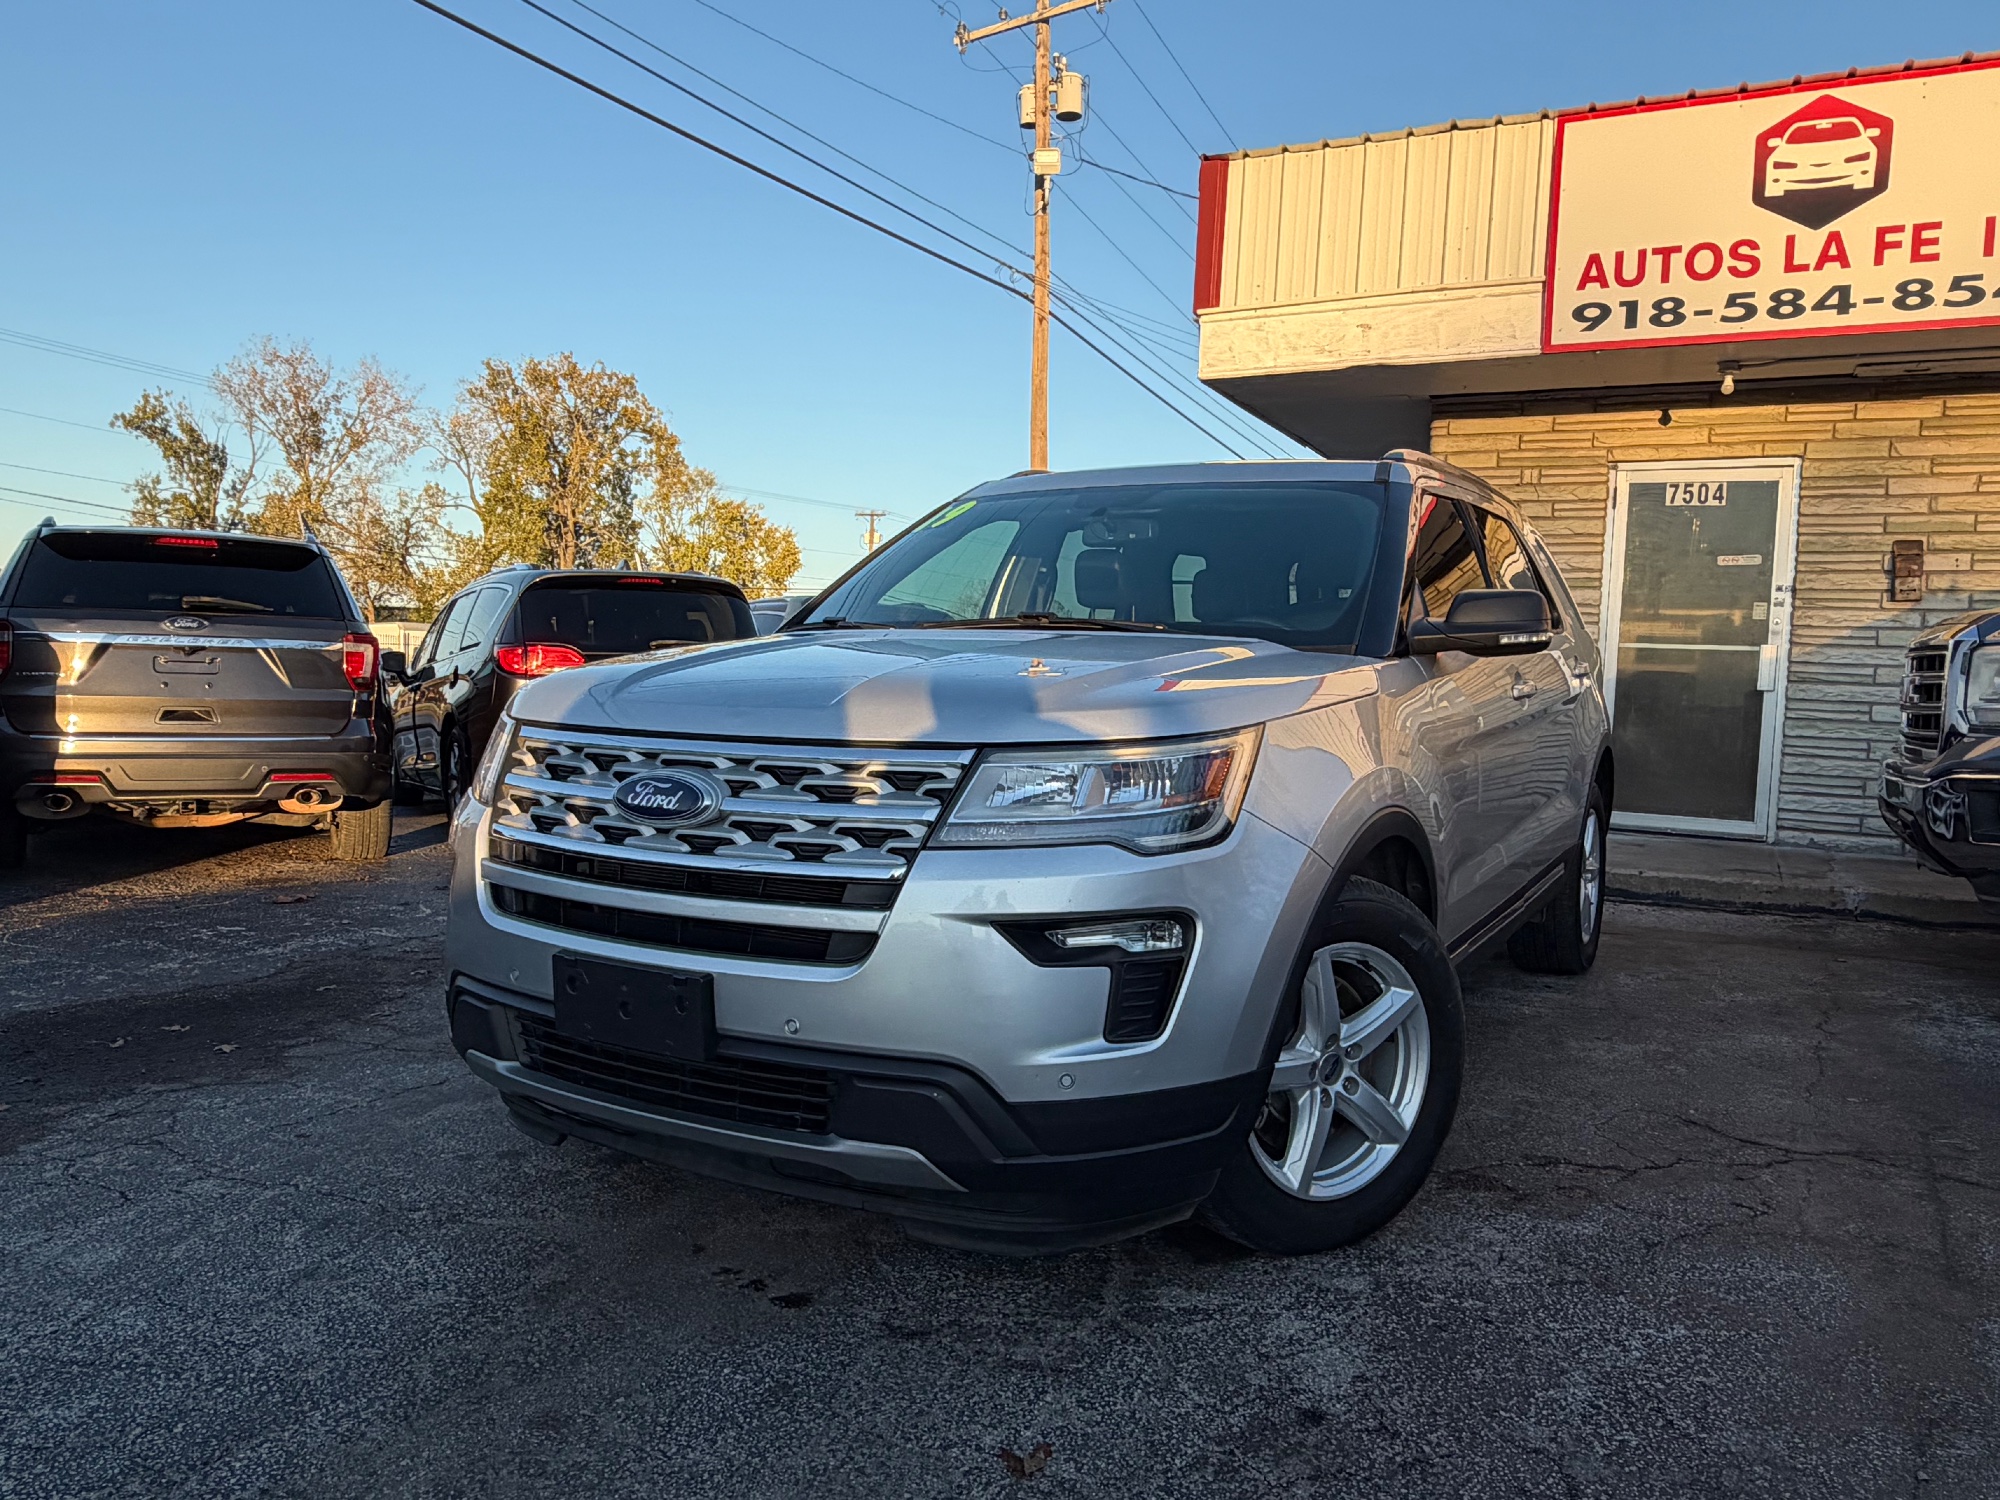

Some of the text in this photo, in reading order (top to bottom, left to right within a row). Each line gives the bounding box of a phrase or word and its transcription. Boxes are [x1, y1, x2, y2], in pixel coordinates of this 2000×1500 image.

[1576, 216, 1997, 291] AUTOS LA FE I
[1571, 273, 2000, 332] 918-584-85
[1669, 482, 1724, 504] 7504
[174, 618, 199, 628] Ford
[627, 780, 684, 810] Ford
